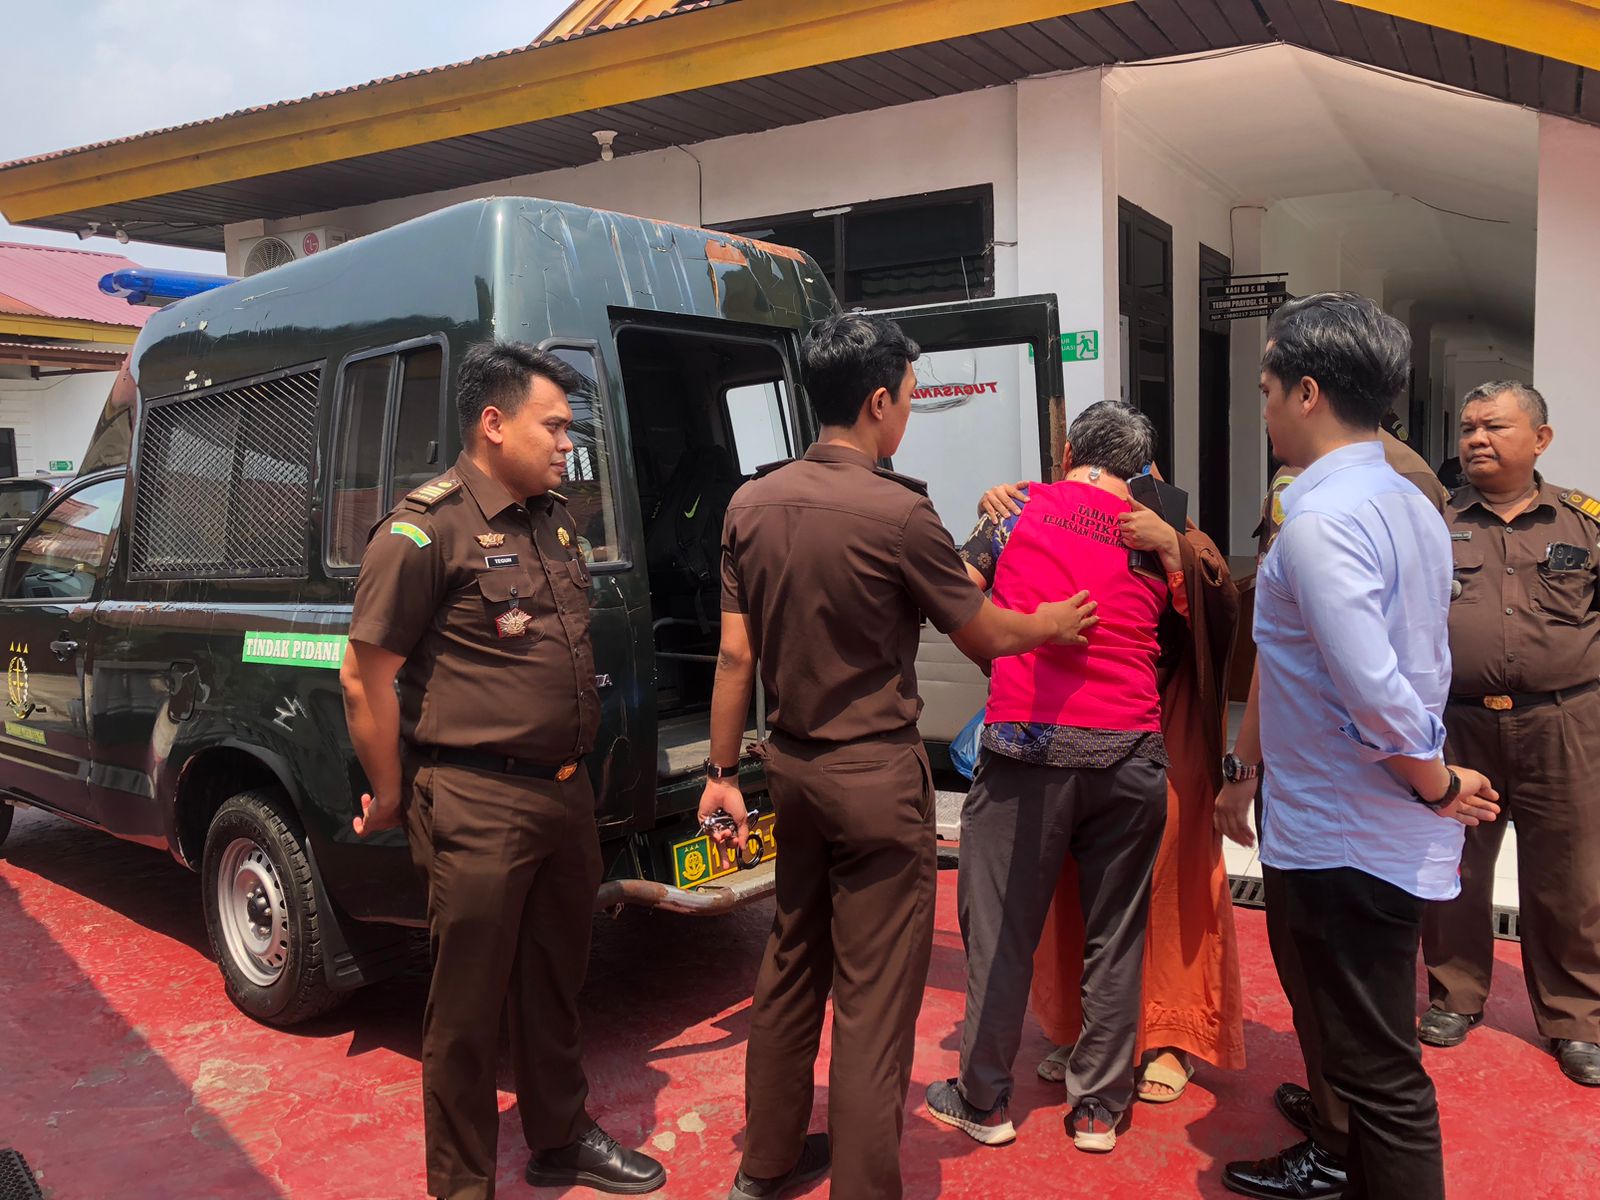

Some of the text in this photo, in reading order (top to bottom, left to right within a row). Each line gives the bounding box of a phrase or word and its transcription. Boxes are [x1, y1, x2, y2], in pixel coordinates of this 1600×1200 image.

[1225, 286, 1240, 294] KASI
[1043, 514, 1089, 537] KEJAKSAAN
[246, 638, 341, 662] TINDAK PIDANA
